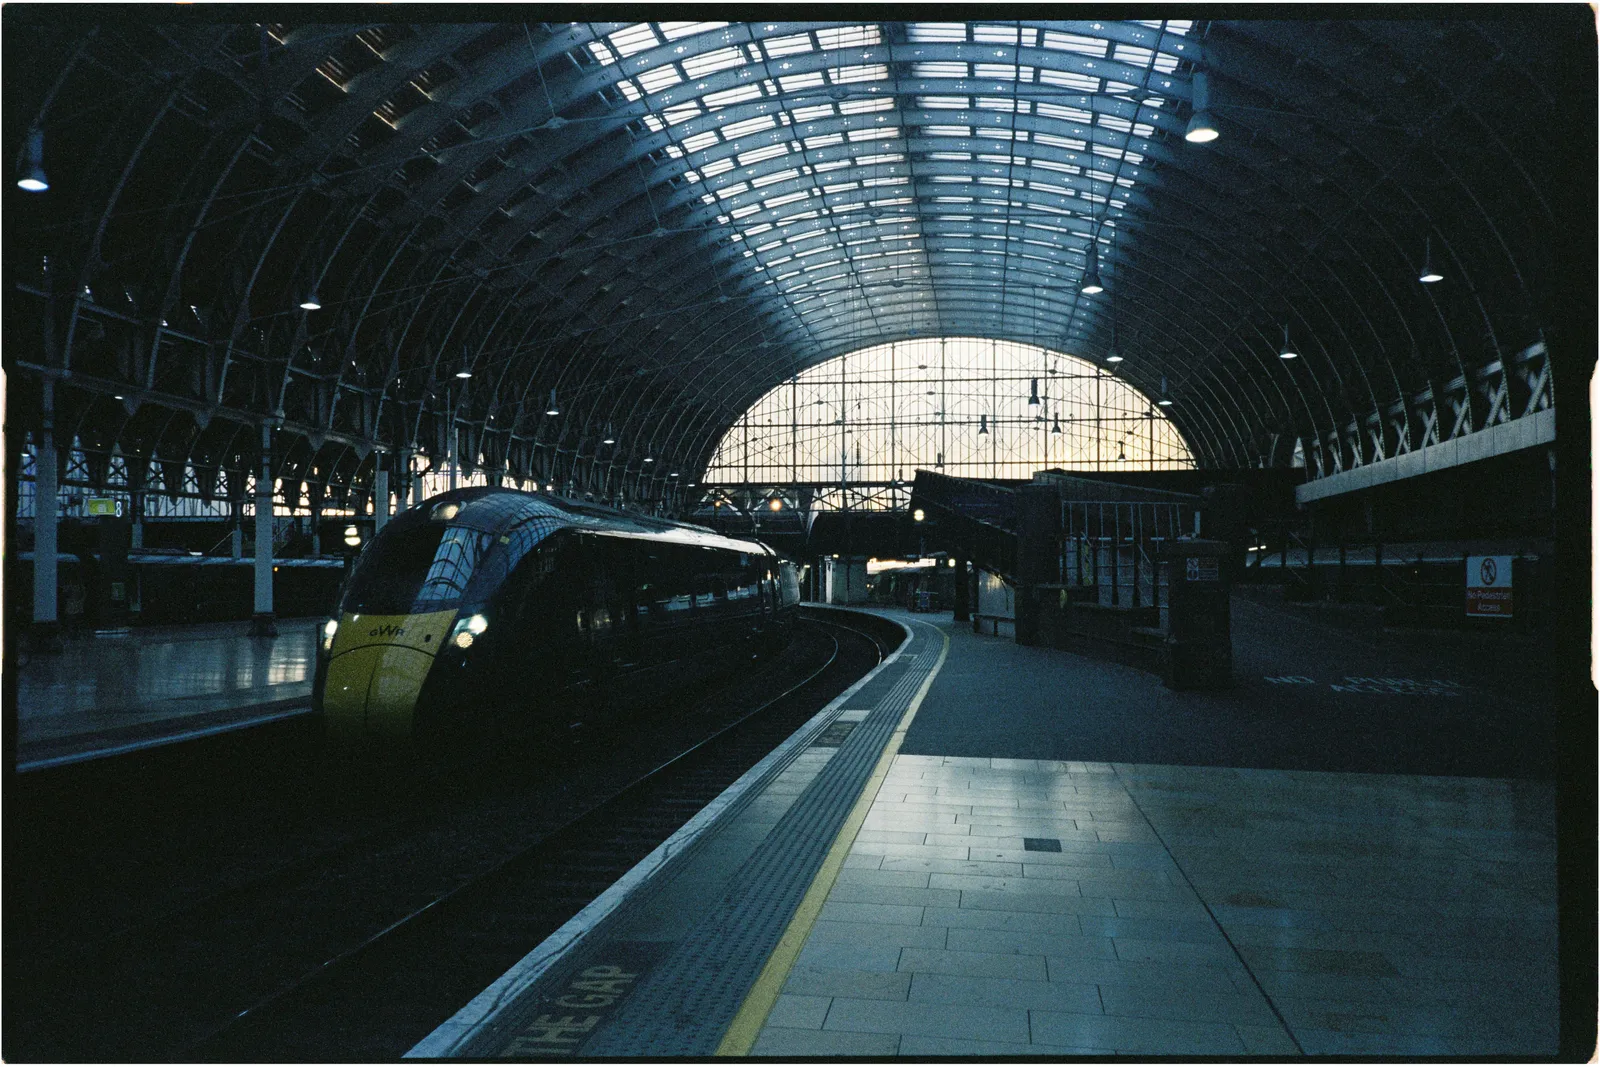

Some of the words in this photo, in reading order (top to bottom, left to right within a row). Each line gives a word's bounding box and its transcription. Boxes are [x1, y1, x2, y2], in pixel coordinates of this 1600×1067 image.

[115, 500, 122, 518] 8
[369, 624, 405, 637] GWR
[554, 965, 640, 1009] GAP
